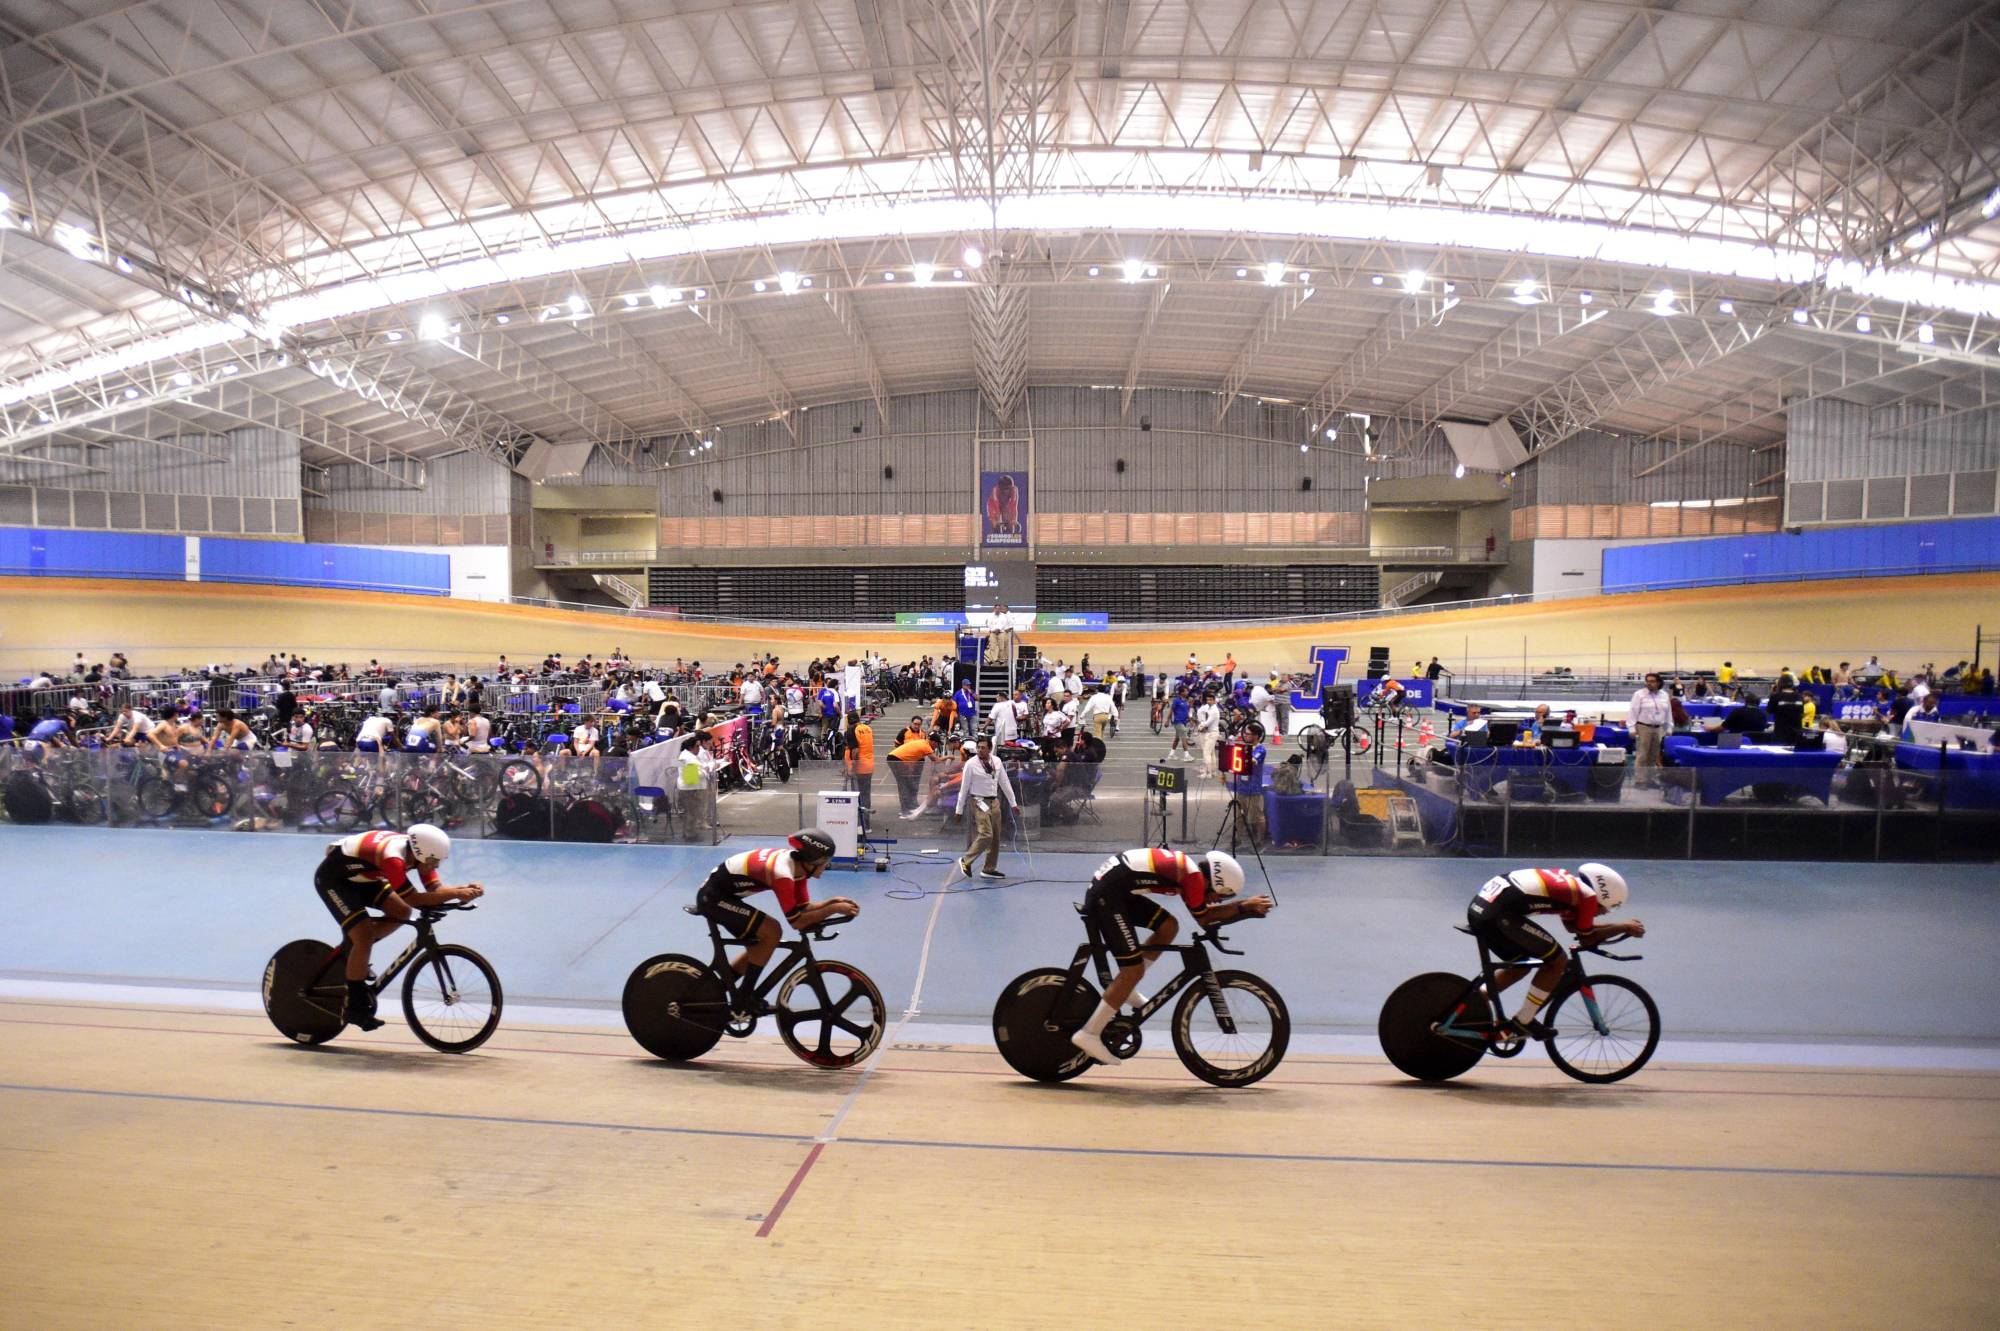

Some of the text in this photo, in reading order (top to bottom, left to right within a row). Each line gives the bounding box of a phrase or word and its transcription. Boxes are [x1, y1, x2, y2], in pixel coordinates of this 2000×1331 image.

[1290, 646, 1351, 712] J
[1406, 689, 1422, 699] DE
[1841, 704, 1871, 714] #SO
[1232, 746, 1243, 772] 6
[1157, 771, 1175, 788] 00
[801, 835, 831, 851] RUDY
[1595, 875, 1611, 901] KASK
[327, 888, 352, 917] SINALOA
[717, 900, 751, 917] SINALOA
[1113, 913, 1138, 952] SINALOA
